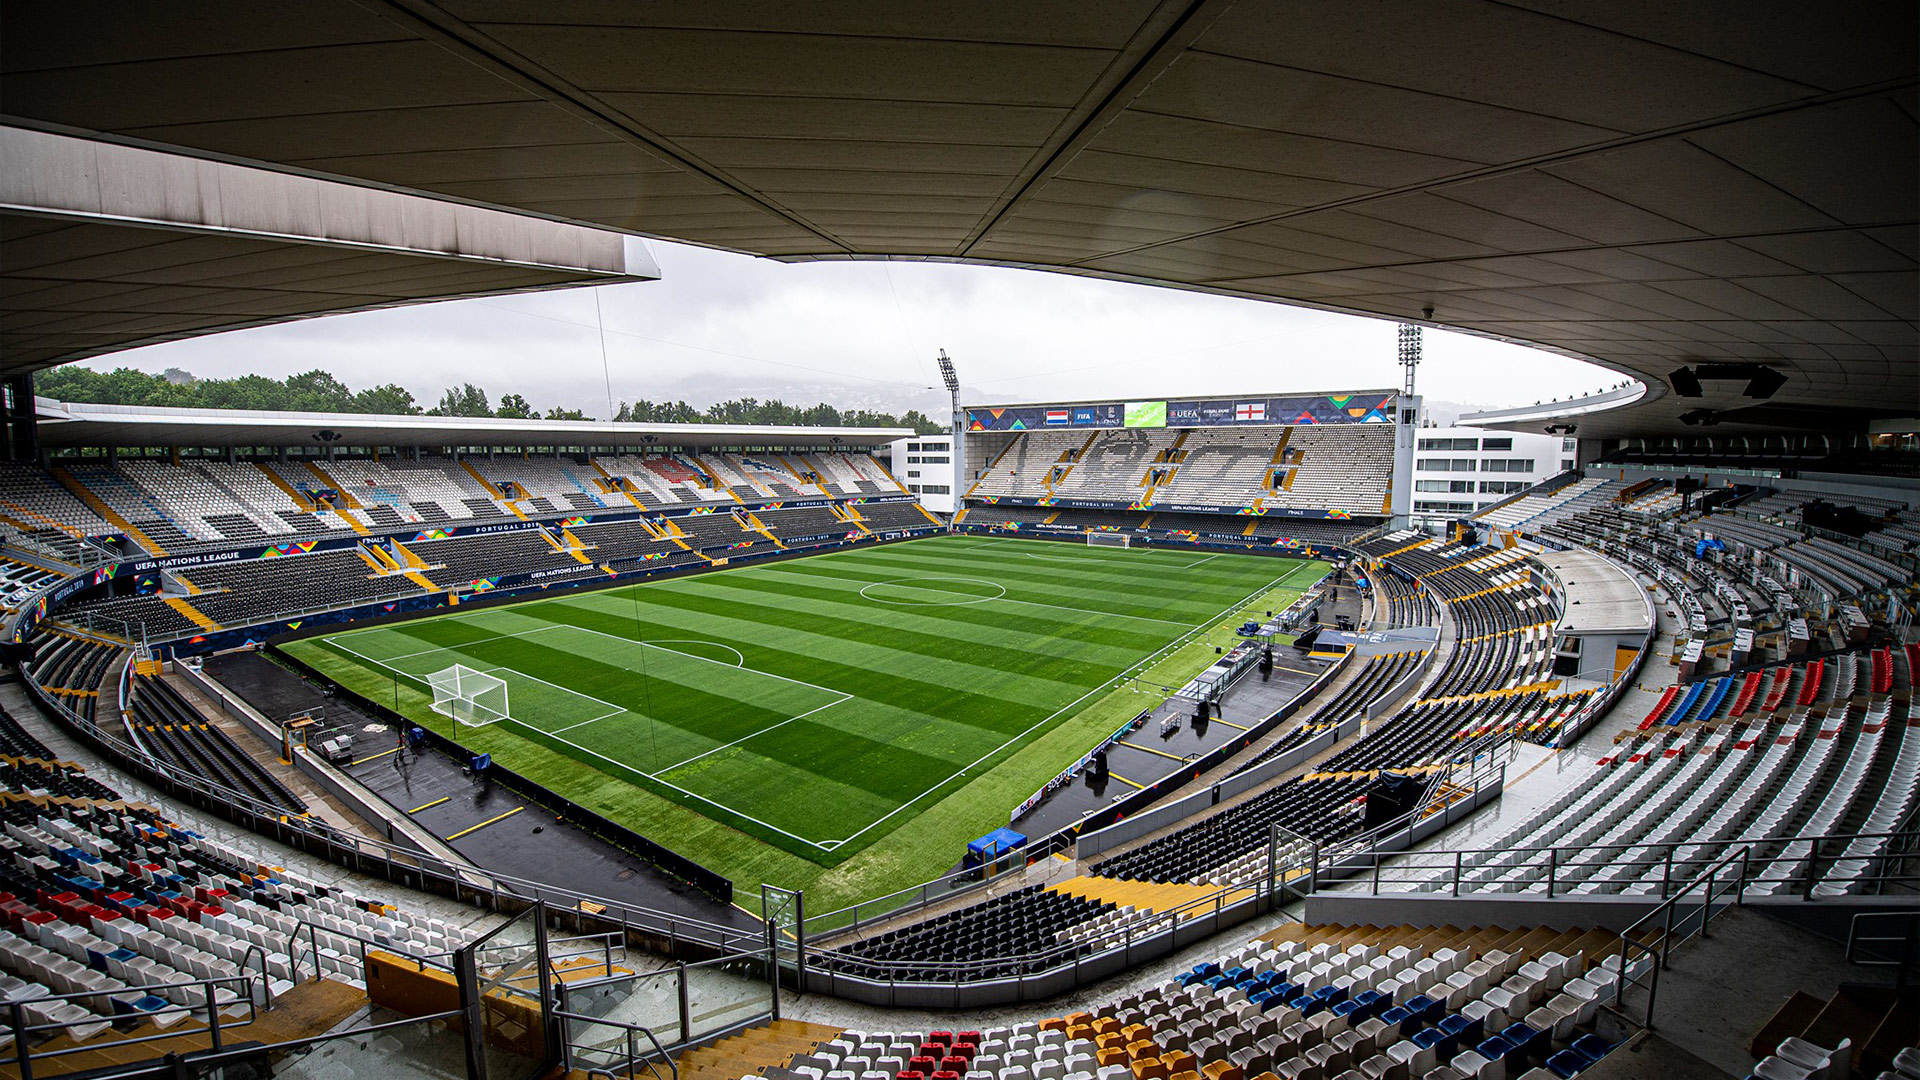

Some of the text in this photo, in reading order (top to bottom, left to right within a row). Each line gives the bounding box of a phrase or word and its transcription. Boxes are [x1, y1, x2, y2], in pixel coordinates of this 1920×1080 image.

[1177, 410, 1197, 418] UEFA
[475, 521, 540, 533] PORTUGAL 2019
[362, 536, 385, 544] FINALS
[787, 535, 816, 543] PORTUGAL
[135, 551, 240, 571] UEFA NATIONS LEAGUE
[531, 564, 595, 579] UEFA NATIONS LEAGUE
